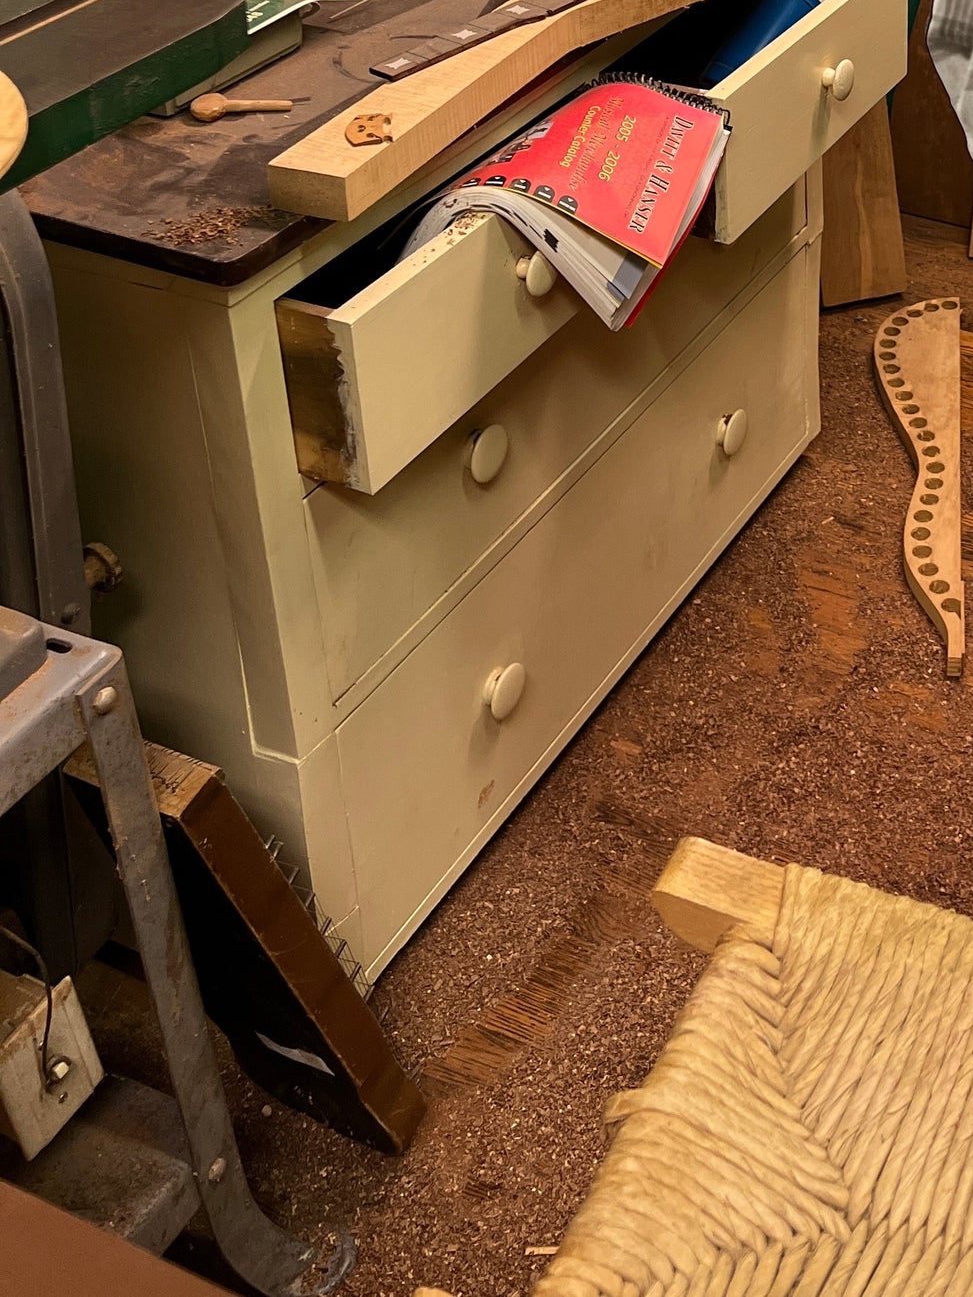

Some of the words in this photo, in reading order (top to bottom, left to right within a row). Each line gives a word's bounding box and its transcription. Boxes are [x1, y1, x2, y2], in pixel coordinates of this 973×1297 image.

[577, 105, 601, 134] Counter
[598, 95, 625, 130] Musical
[617, 114, 636, 143] 2005
[560, 135, 586, 168] Catalog
[661, 115, 694, 159] DAVITT
[568, 129, 607, 193] Merchandise
[598, 150, 621, 182] 2006
[655, 160, 674, 174] &
[628, 173, 671, 234] HANSER
